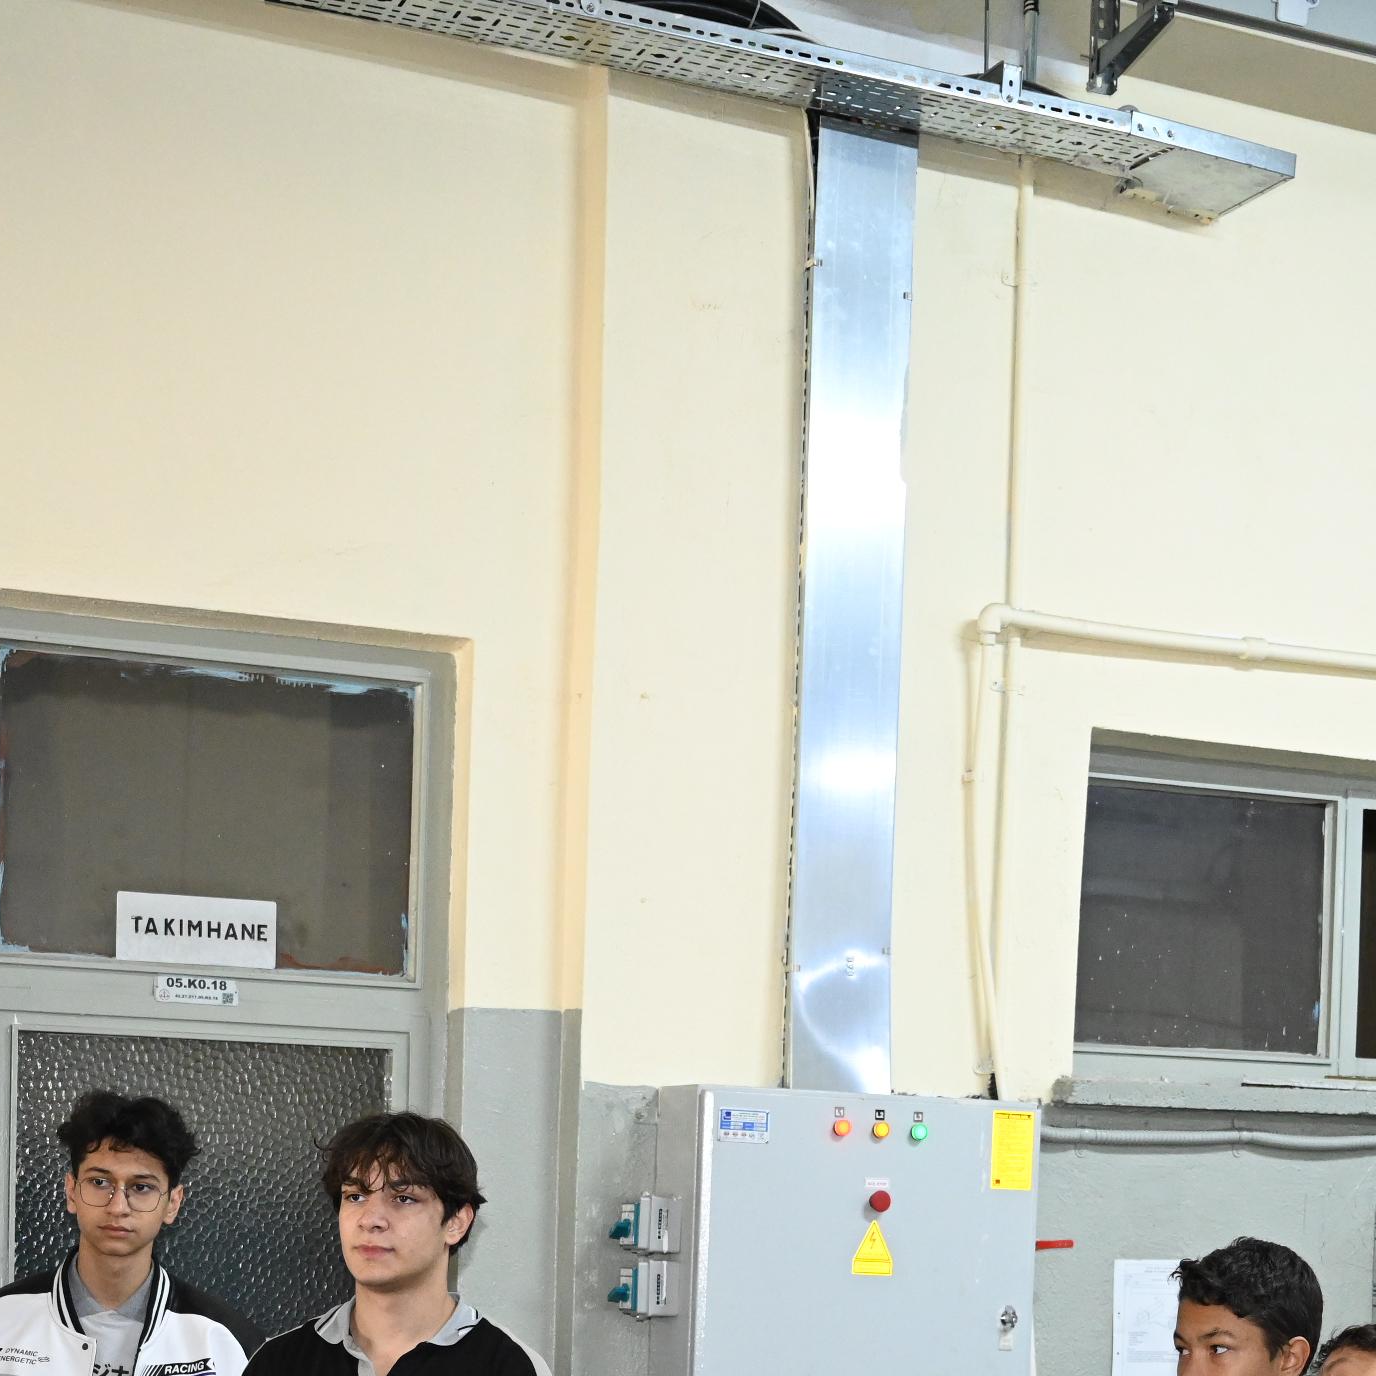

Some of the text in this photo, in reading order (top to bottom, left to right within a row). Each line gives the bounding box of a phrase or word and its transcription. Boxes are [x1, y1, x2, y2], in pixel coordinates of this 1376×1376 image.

[131, 915, 268, 941] TAKIMHANE
[166, 977, 227, 991] 05.K0.18
[5, 1347, 38, 1357] DYNAMIC
[164, 1361, 205, 1374] RACING
